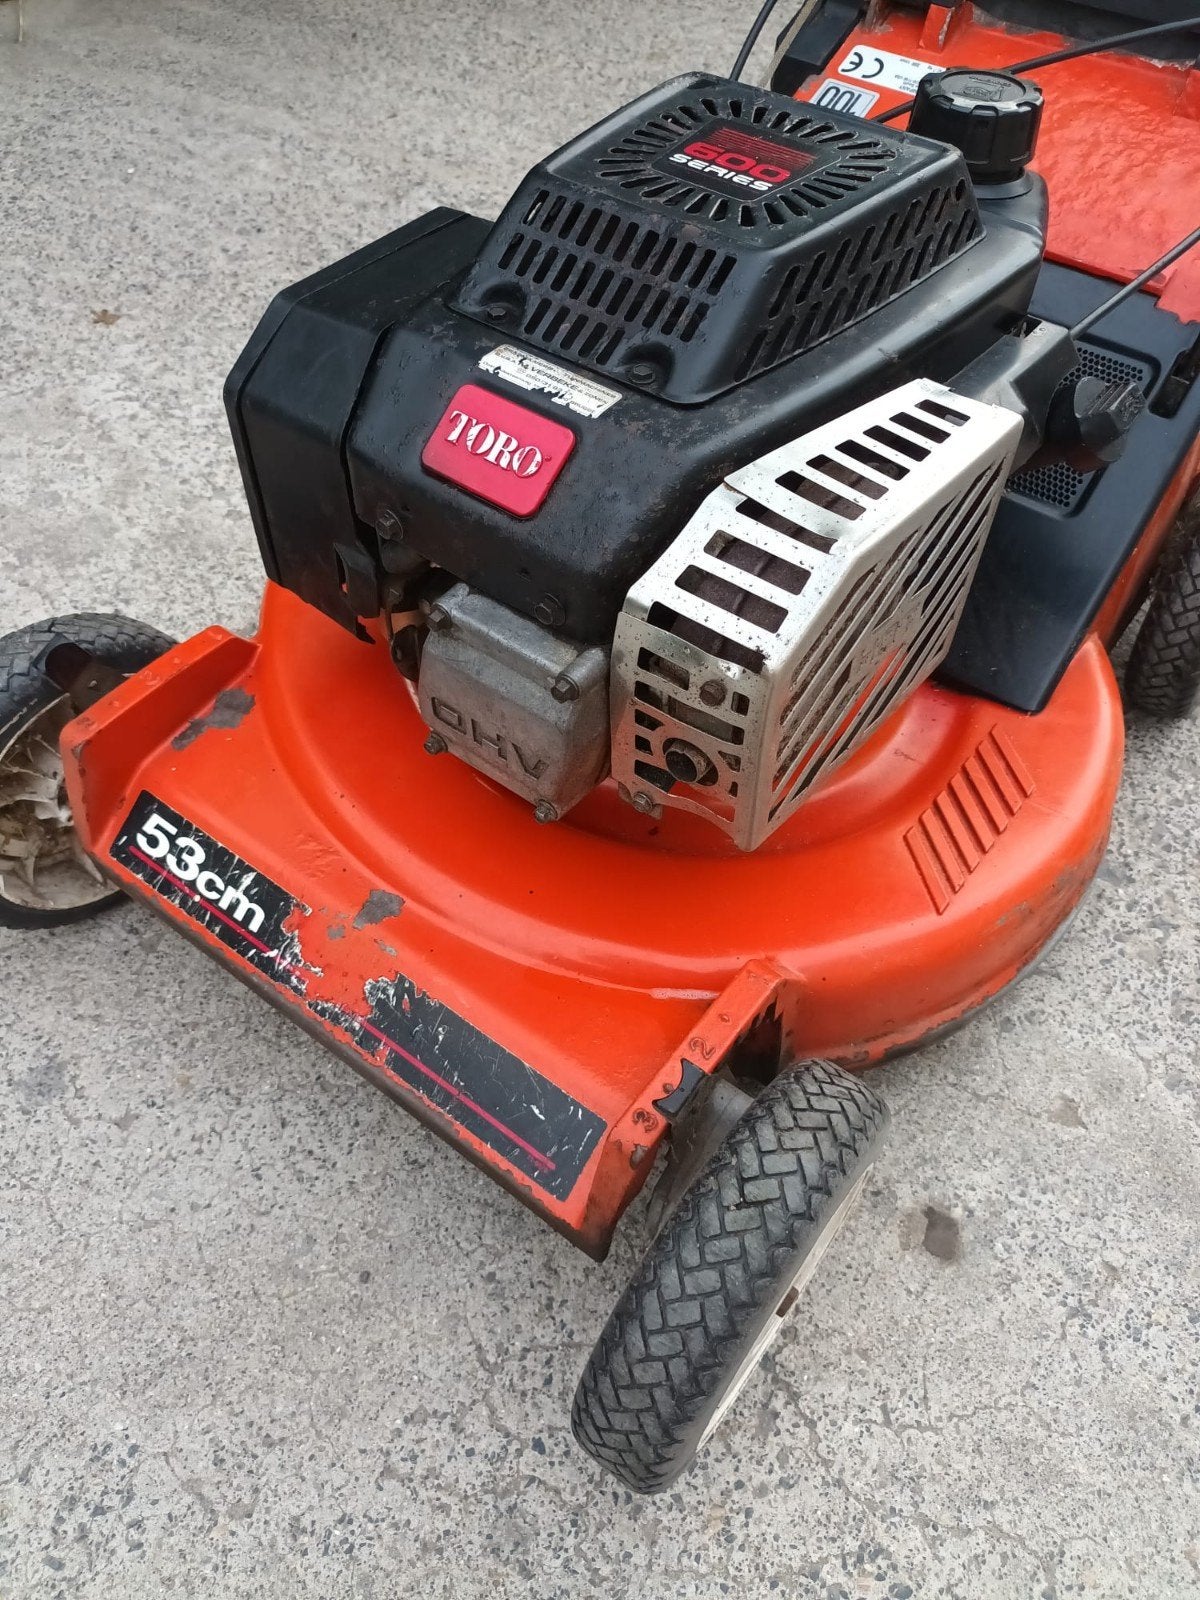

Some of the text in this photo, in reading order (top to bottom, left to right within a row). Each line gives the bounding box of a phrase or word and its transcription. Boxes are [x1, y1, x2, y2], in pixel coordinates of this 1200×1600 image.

[669, 153, 774, 191] SERIES
[683, 141, 791, 183] 600
[446, 410, 542, 478] TORO
[431, 696, 549, 780] OHV
[136, 813, 265, 934] 53cm
[689, 1036, 717, 1060] 2
